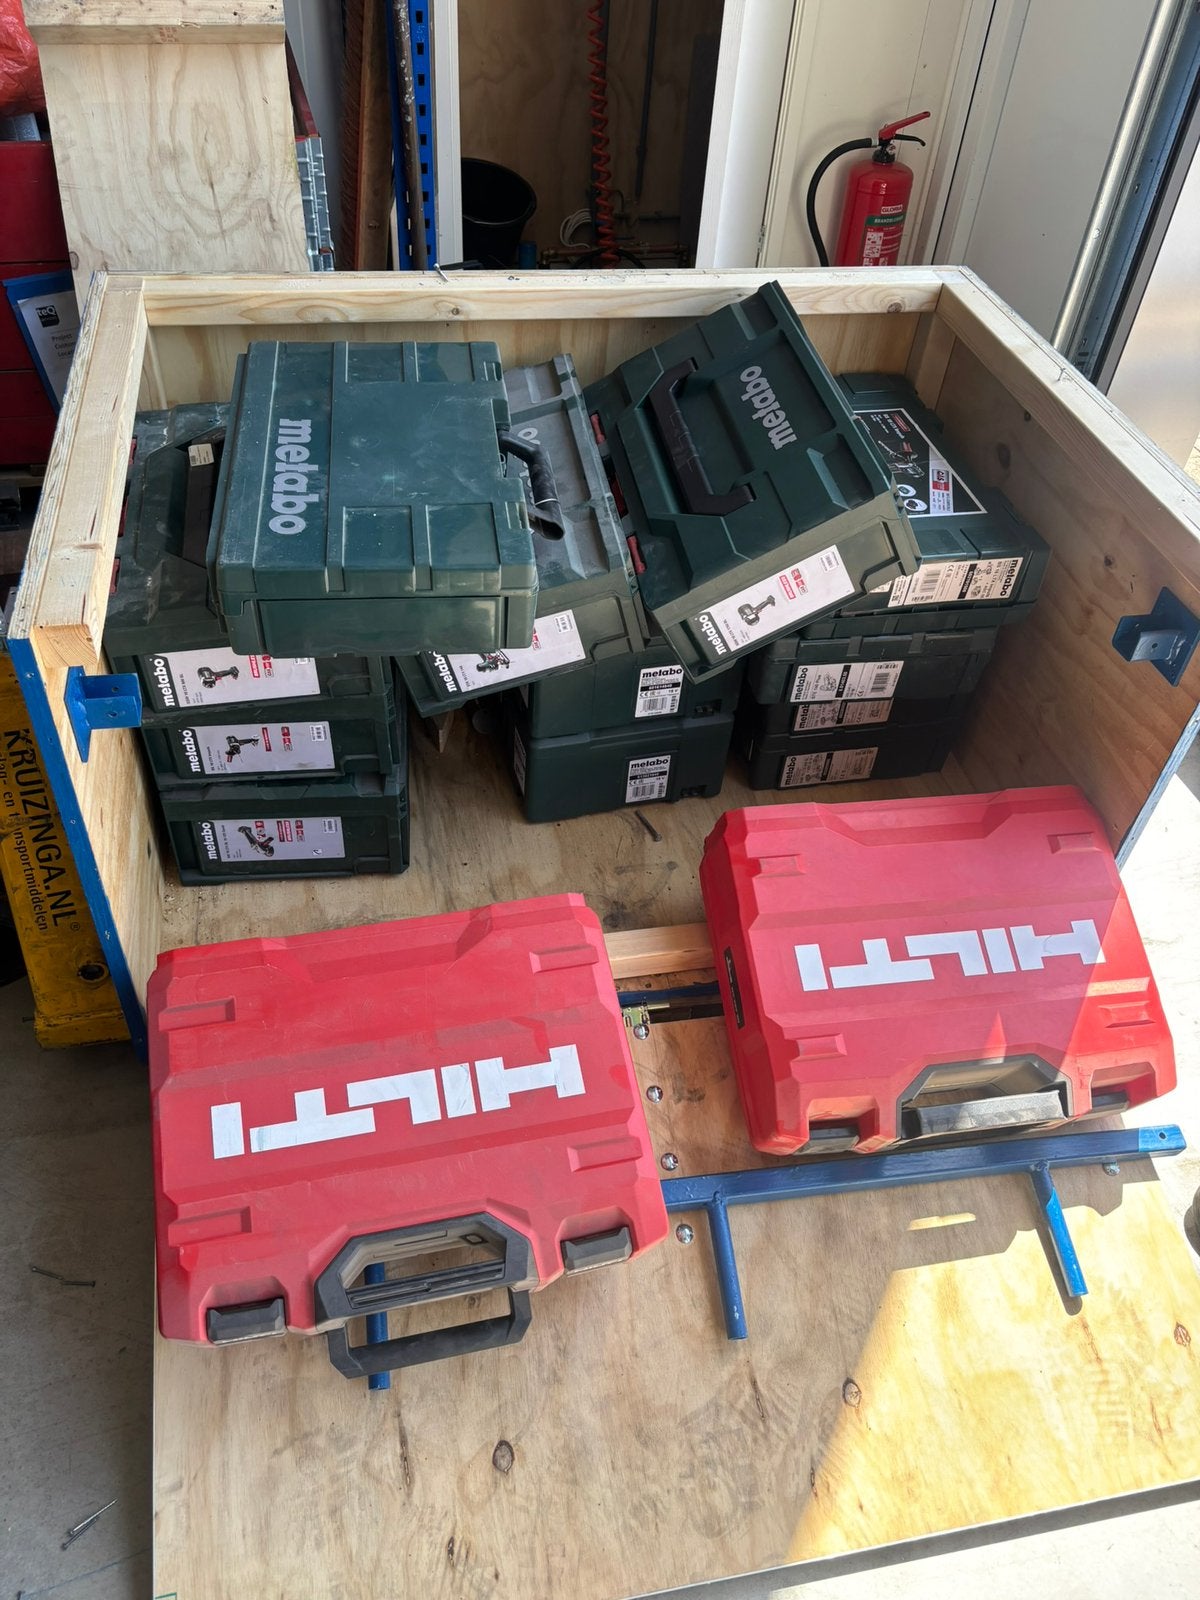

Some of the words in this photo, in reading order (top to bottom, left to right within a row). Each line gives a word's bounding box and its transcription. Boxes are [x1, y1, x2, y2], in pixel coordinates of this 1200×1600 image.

[739, 364, 799, 450] metabo
[268, 418, 320, 535] metabo
[1000, 559, 1019, 597] metabo
[699, 613, 727, 656] metabo
[154, 657, 175, 706] metabo
[642, 668, 682, 678] metabo
[795, 667, 808, 700] metabo
[183, 729, 201, 773] metabo
[631, 759, 668, 768] metabo
[785, 756, 797, 787] metabo
[3, 791, 15, 807] en
[9, 811, 48, 931] tnsportmiddelen
[200, 822, 217, 860] metabo
[794, 918, 1107, 993] HILTI
[211, 1043, 586, 1160] HILTI
